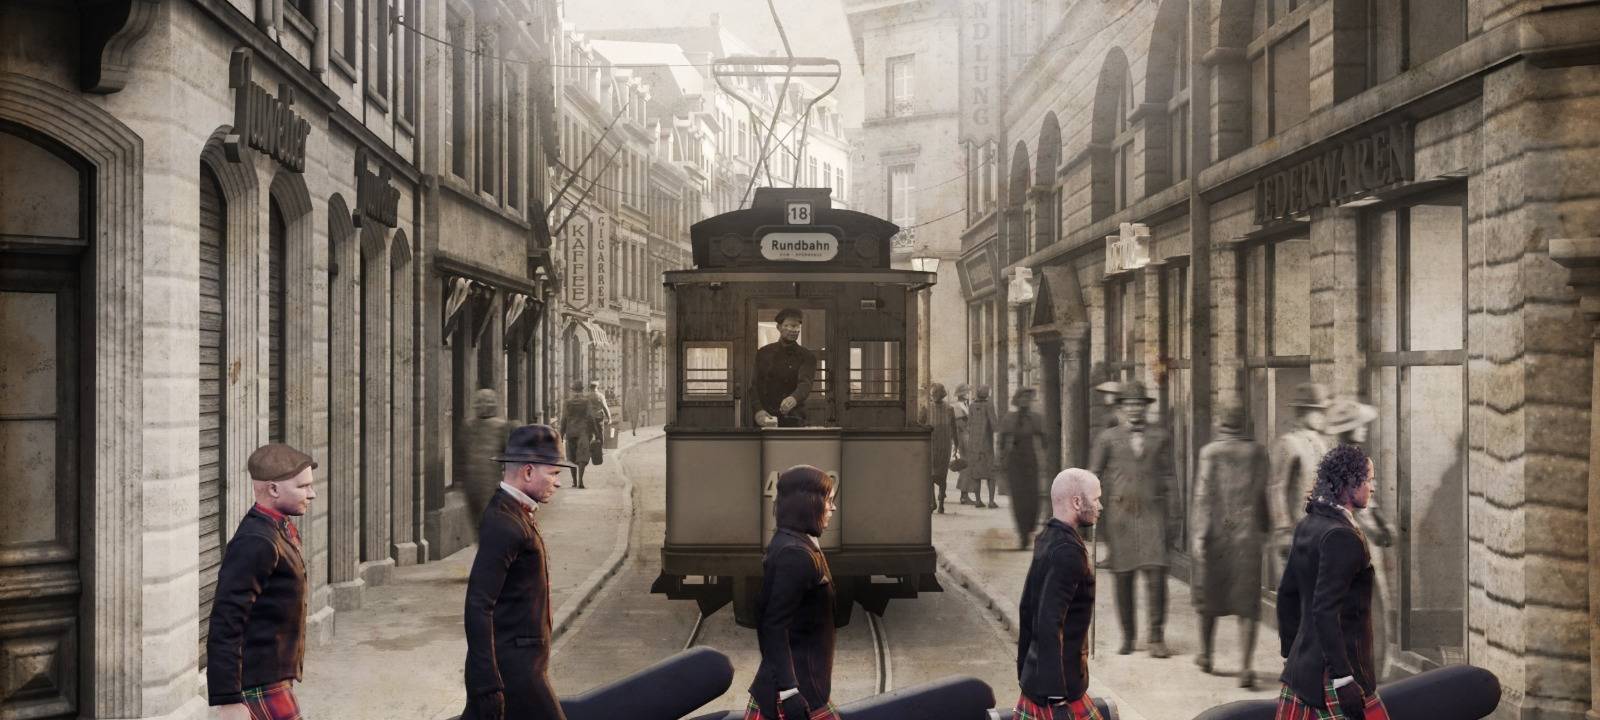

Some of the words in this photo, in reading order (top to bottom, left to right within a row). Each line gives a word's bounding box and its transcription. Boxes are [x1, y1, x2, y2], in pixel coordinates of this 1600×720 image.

[791, 207, 807, 220] 18
[772, 240, 830, 251] Rundbahn
[572, 224, 585, 301] KAFFEE
